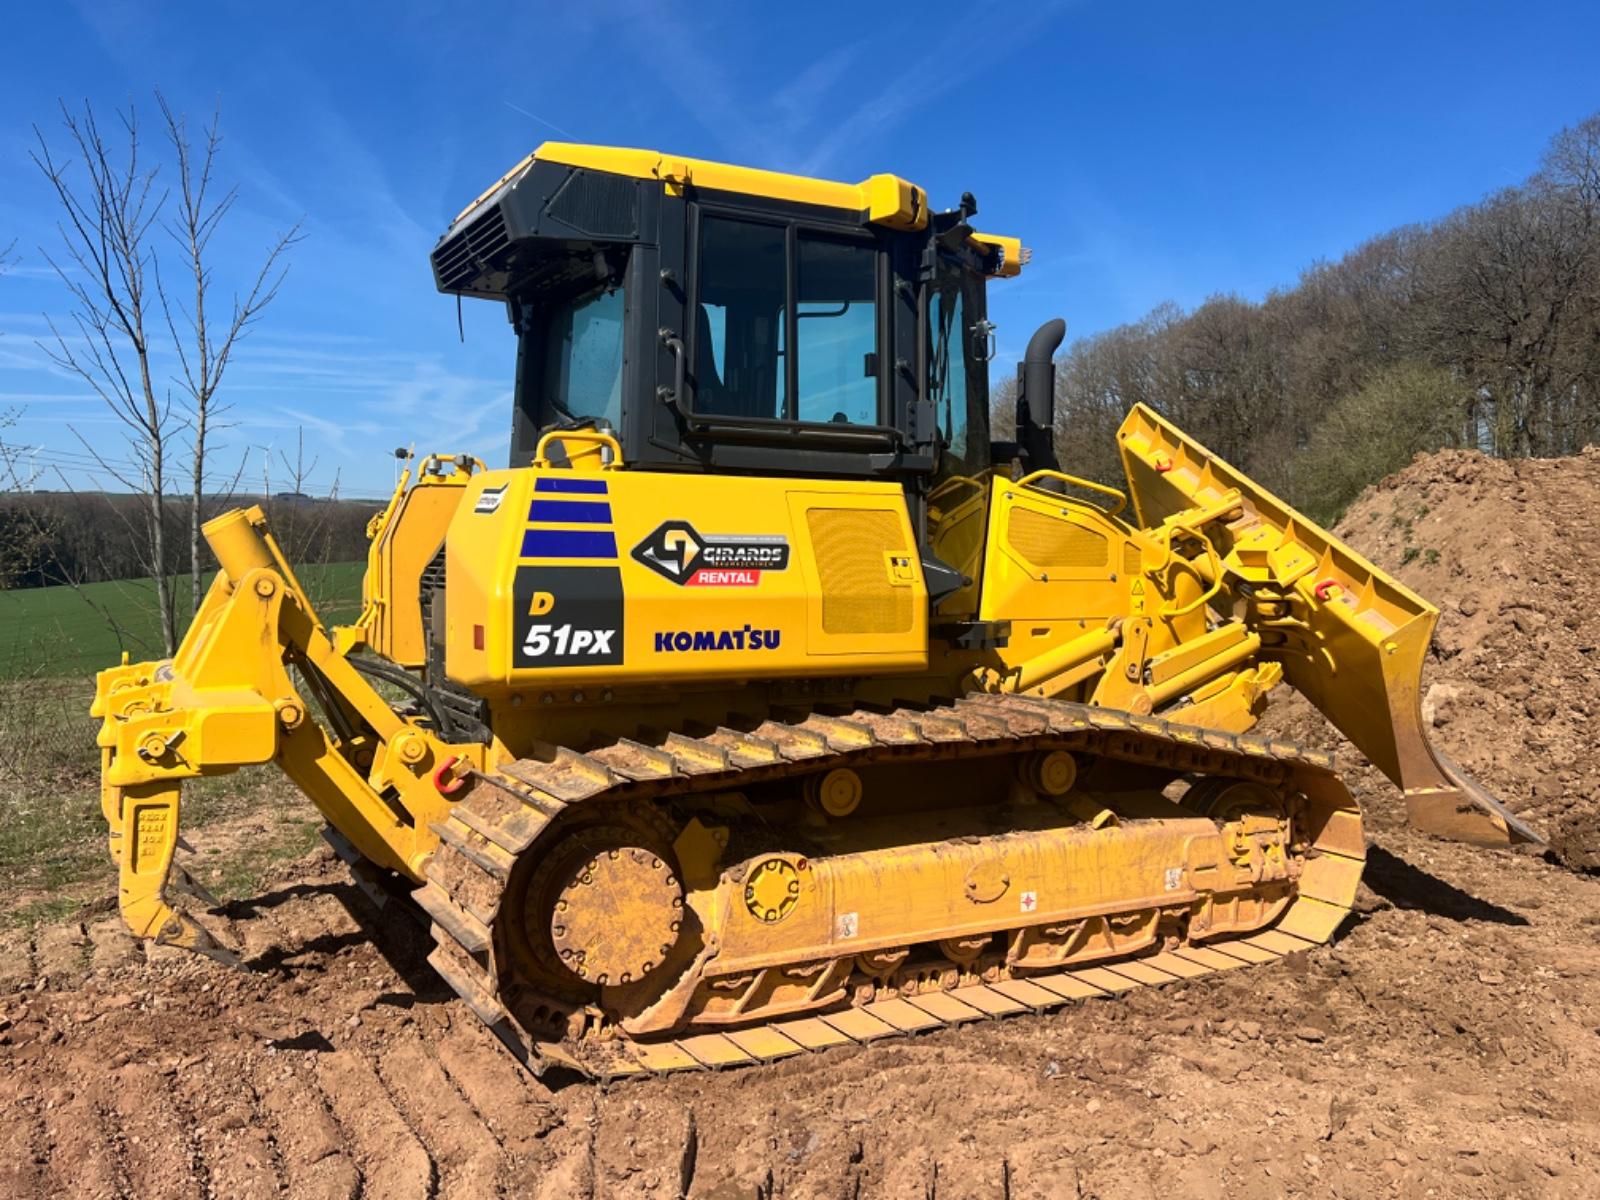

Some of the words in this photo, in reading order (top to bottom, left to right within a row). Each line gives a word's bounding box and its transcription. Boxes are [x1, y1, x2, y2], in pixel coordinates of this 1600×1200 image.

[703, 547, 782, 564] GIRARDS
[698, 572, 755, 584] RENTAL
[528, 591, 555, 616] D
[522, 624, 616, 656] 51PX
[655, 624, 780, 652] KOMATSU
